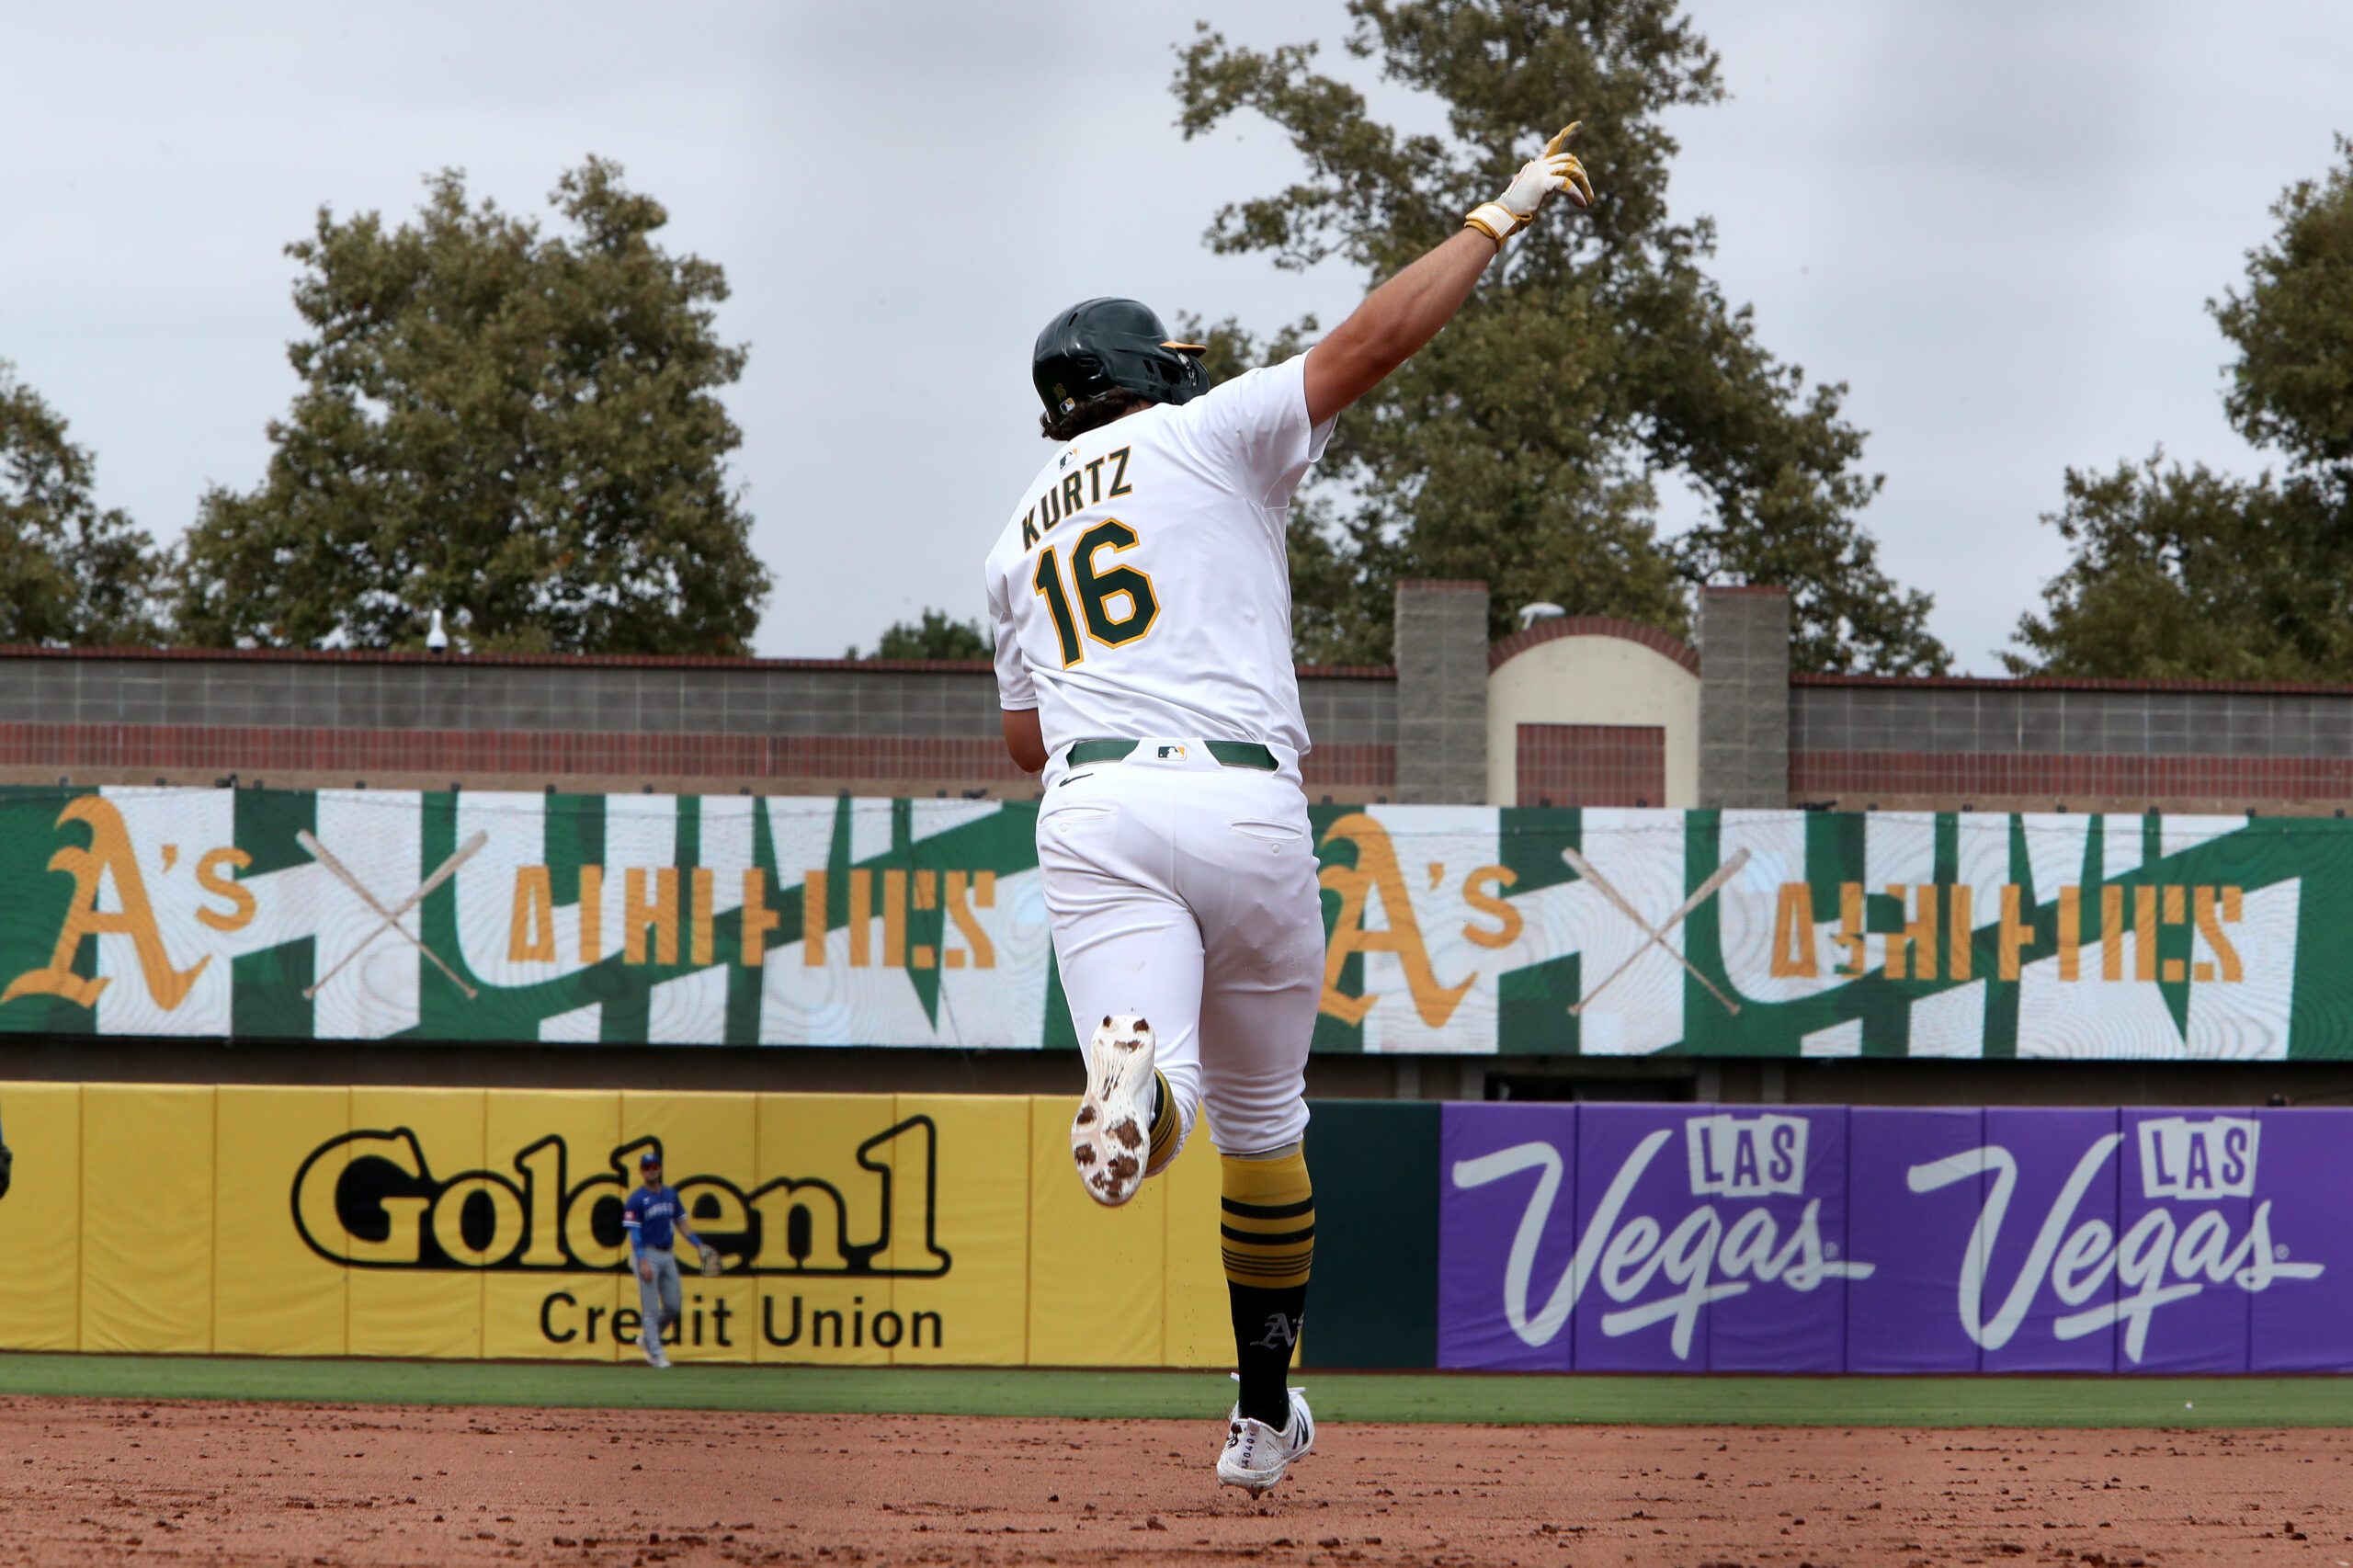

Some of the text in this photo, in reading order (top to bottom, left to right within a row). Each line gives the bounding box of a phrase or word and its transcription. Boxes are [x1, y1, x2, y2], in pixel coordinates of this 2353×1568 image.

[1021, 445, 1133, 554] KURTZ
[1031, 517, 1162, 672] 16
[1699, 1123, 1797, 1188] LAS
[2151, 1126, 2248, 1190] LAS
[1451, 1130, 1876, 1361] Vegas
[1906, 1131, 2326, 1365] Vegas
[763, 1295, 944, 1349] Union
